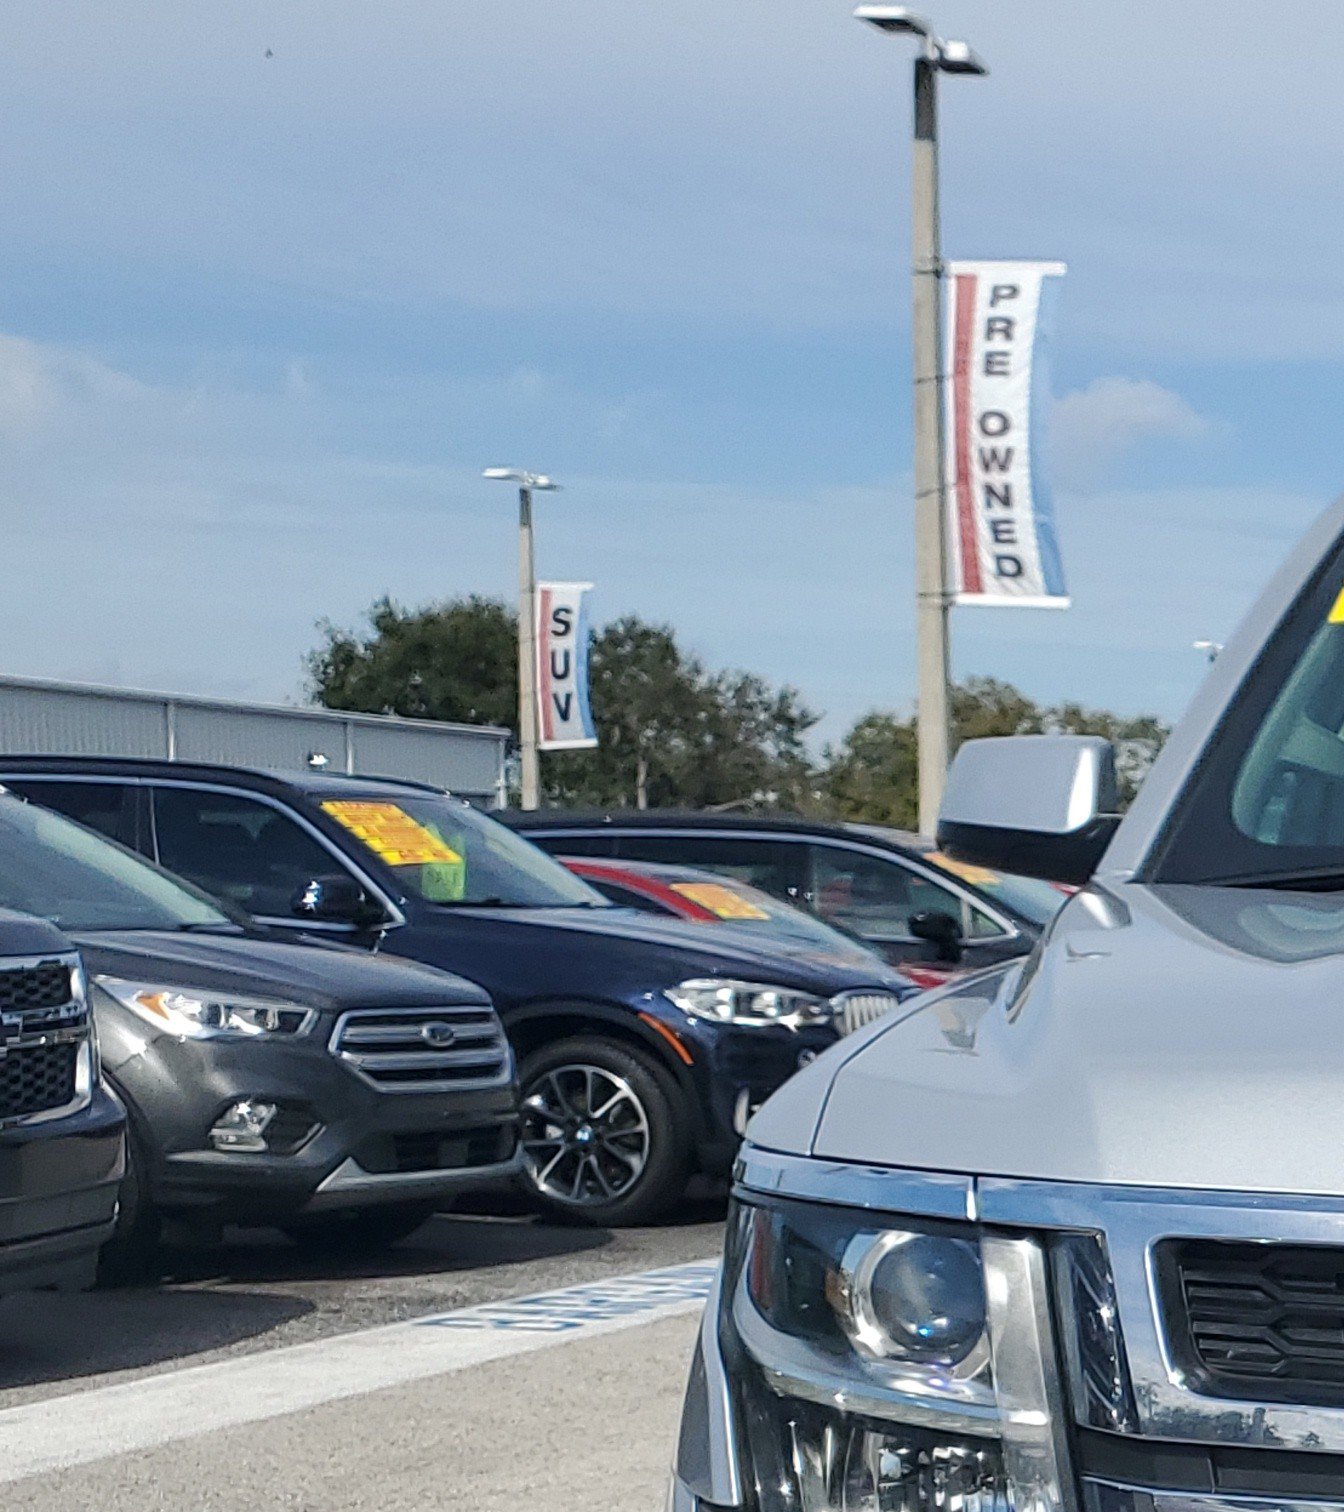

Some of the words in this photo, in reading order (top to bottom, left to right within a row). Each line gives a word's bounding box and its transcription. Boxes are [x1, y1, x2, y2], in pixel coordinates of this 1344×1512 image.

[983, 284, 1020, 377] PRE
[978, 410, 1024, 579] OWNED
[550, 607, 573, 722] SUV
